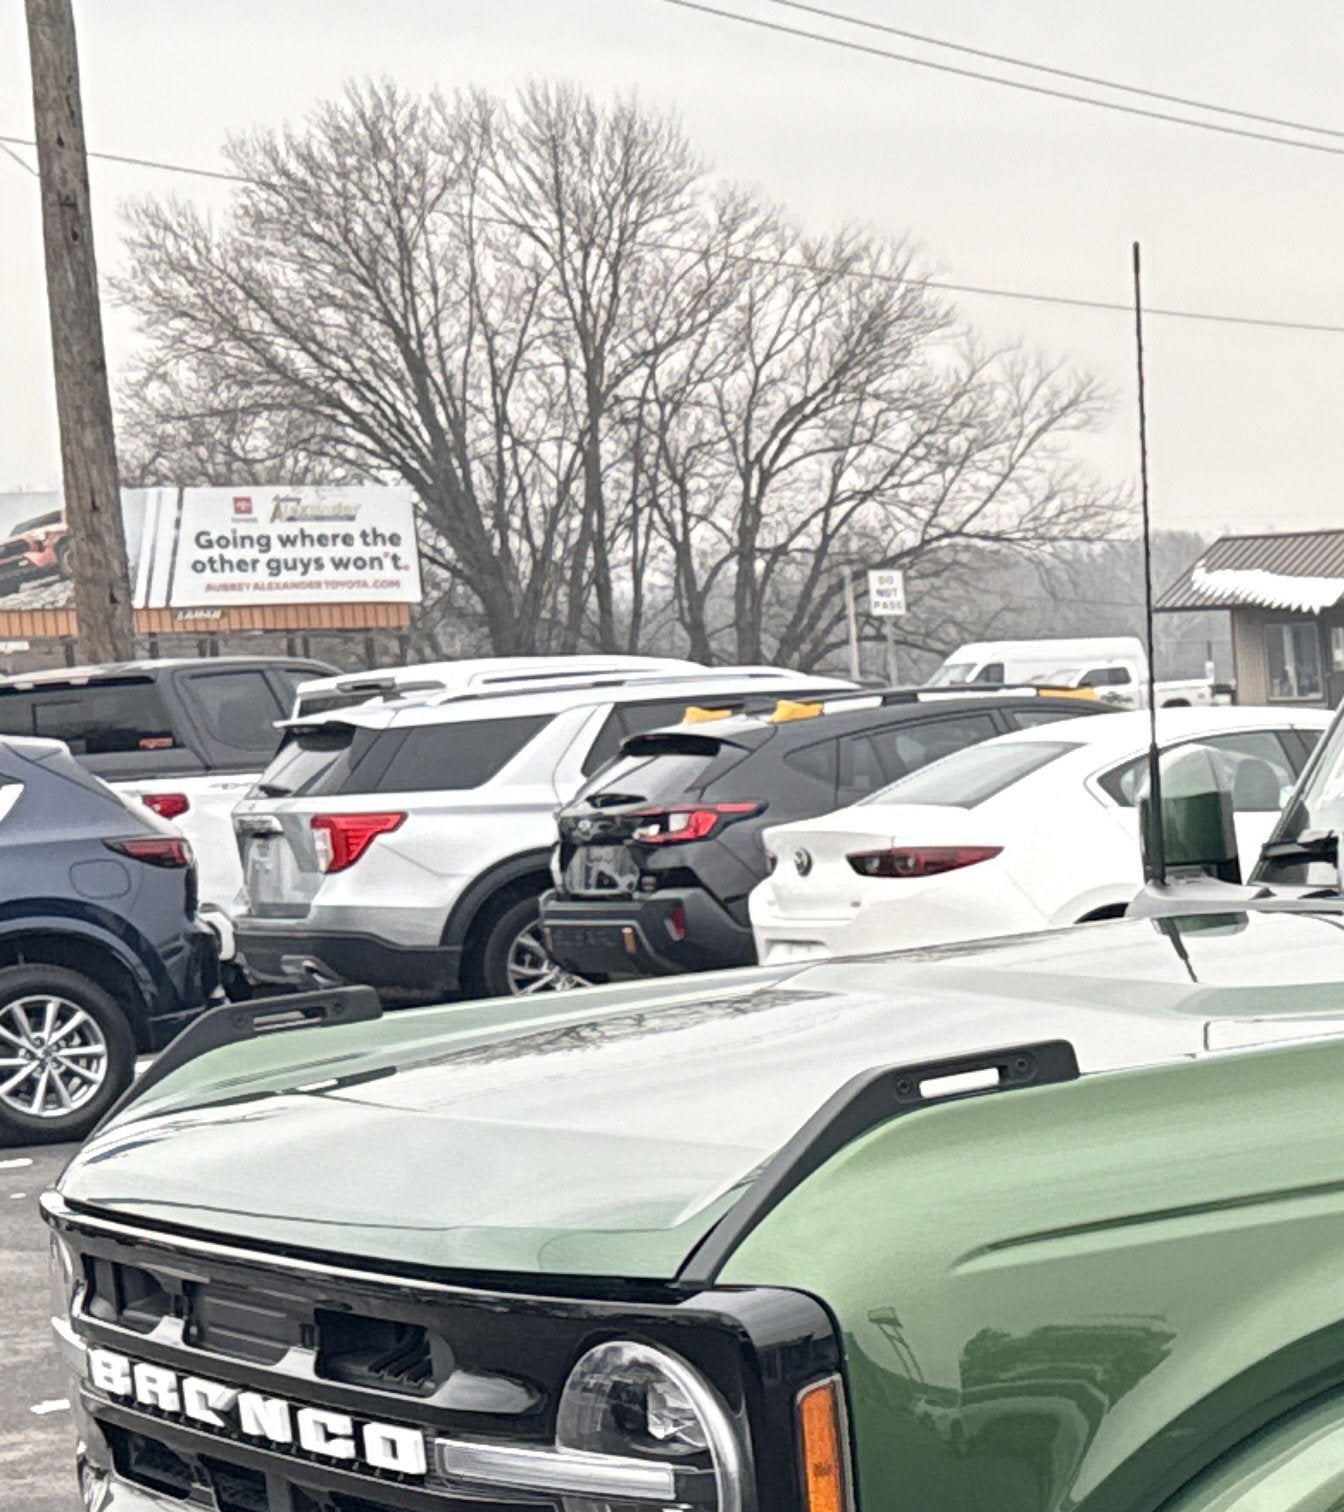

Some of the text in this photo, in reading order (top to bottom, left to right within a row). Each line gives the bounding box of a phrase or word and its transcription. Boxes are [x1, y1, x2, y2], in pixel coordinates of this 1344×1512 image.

[194, 527, 402, 554] Going where the
[191, 551, 410, 577] other guys won't.
[88, 1347, 428, 1475] BRONCO
